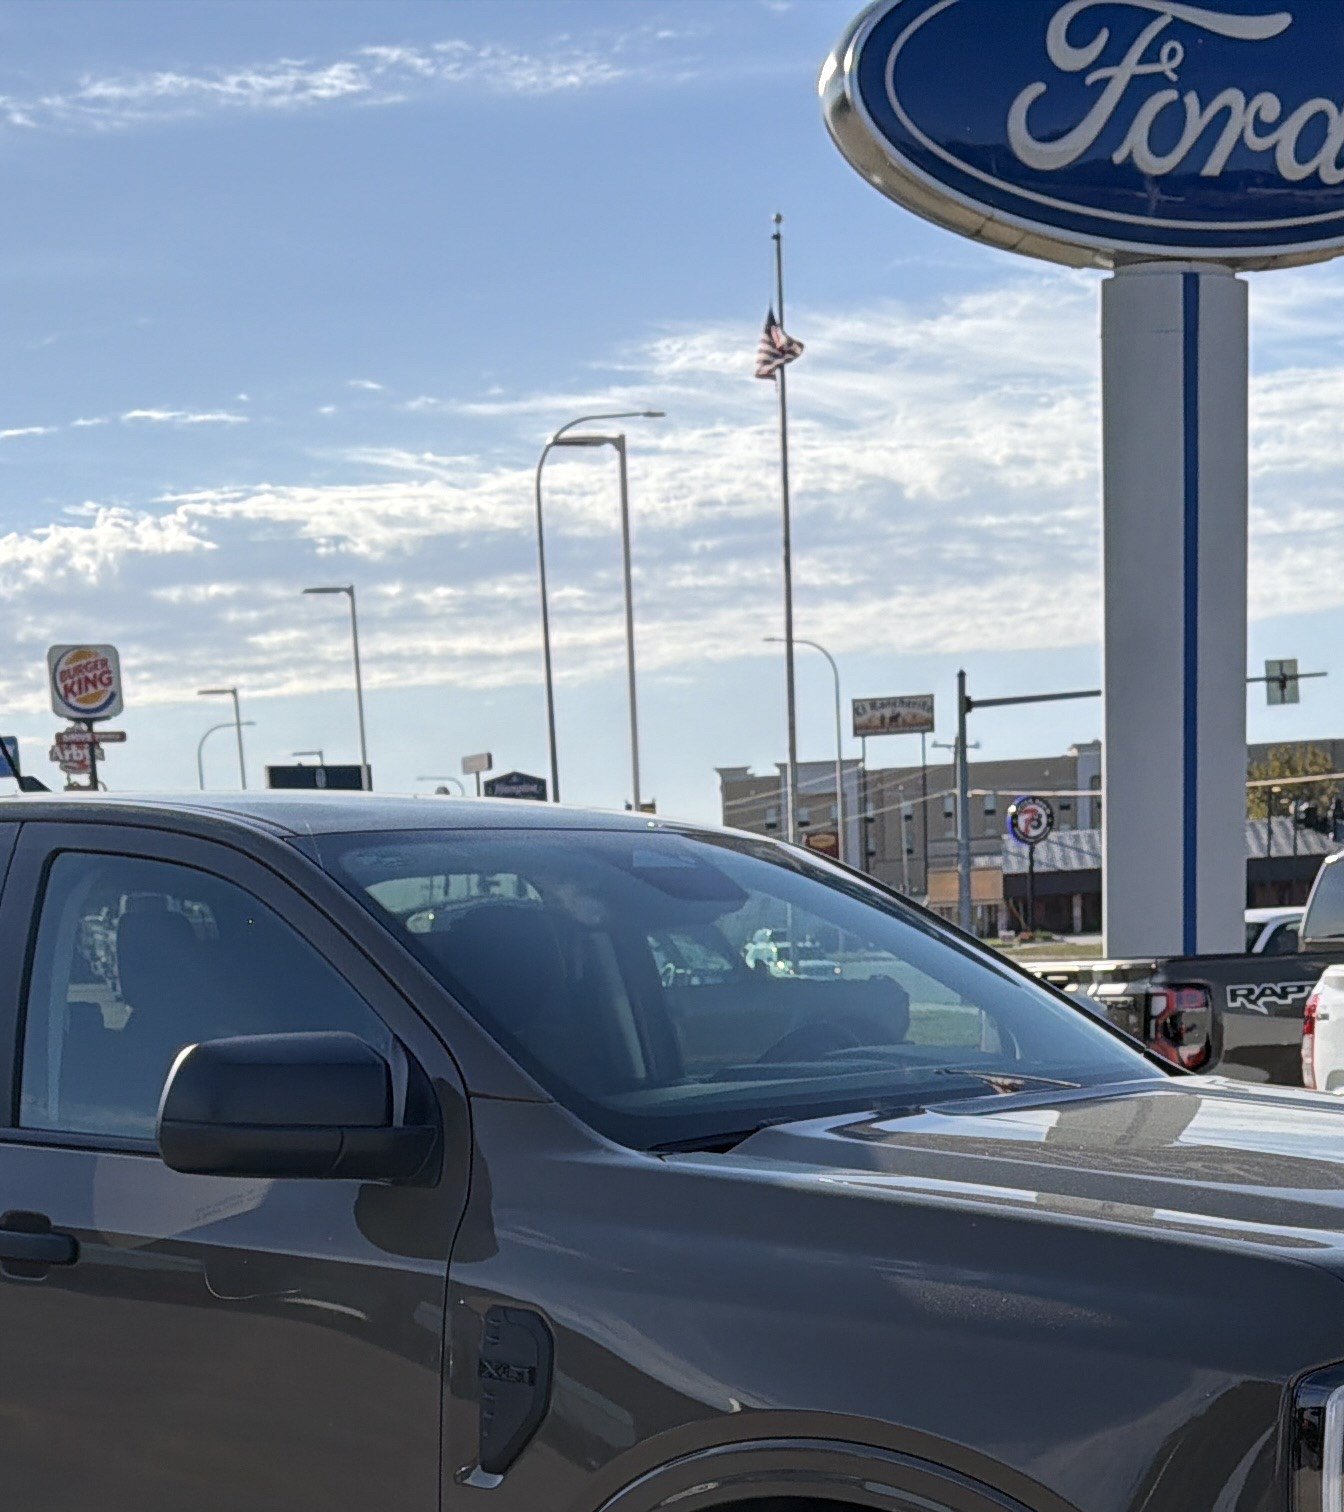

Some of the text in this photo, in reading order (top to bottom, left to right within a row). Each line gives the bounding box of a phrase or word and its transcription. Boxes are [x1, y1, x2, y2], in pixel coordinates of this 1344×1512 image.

[59, 657, 109, 683] BURGER
[62, 669, 113, 700] KING
[1226, 981, 1317, 1015] RAP
